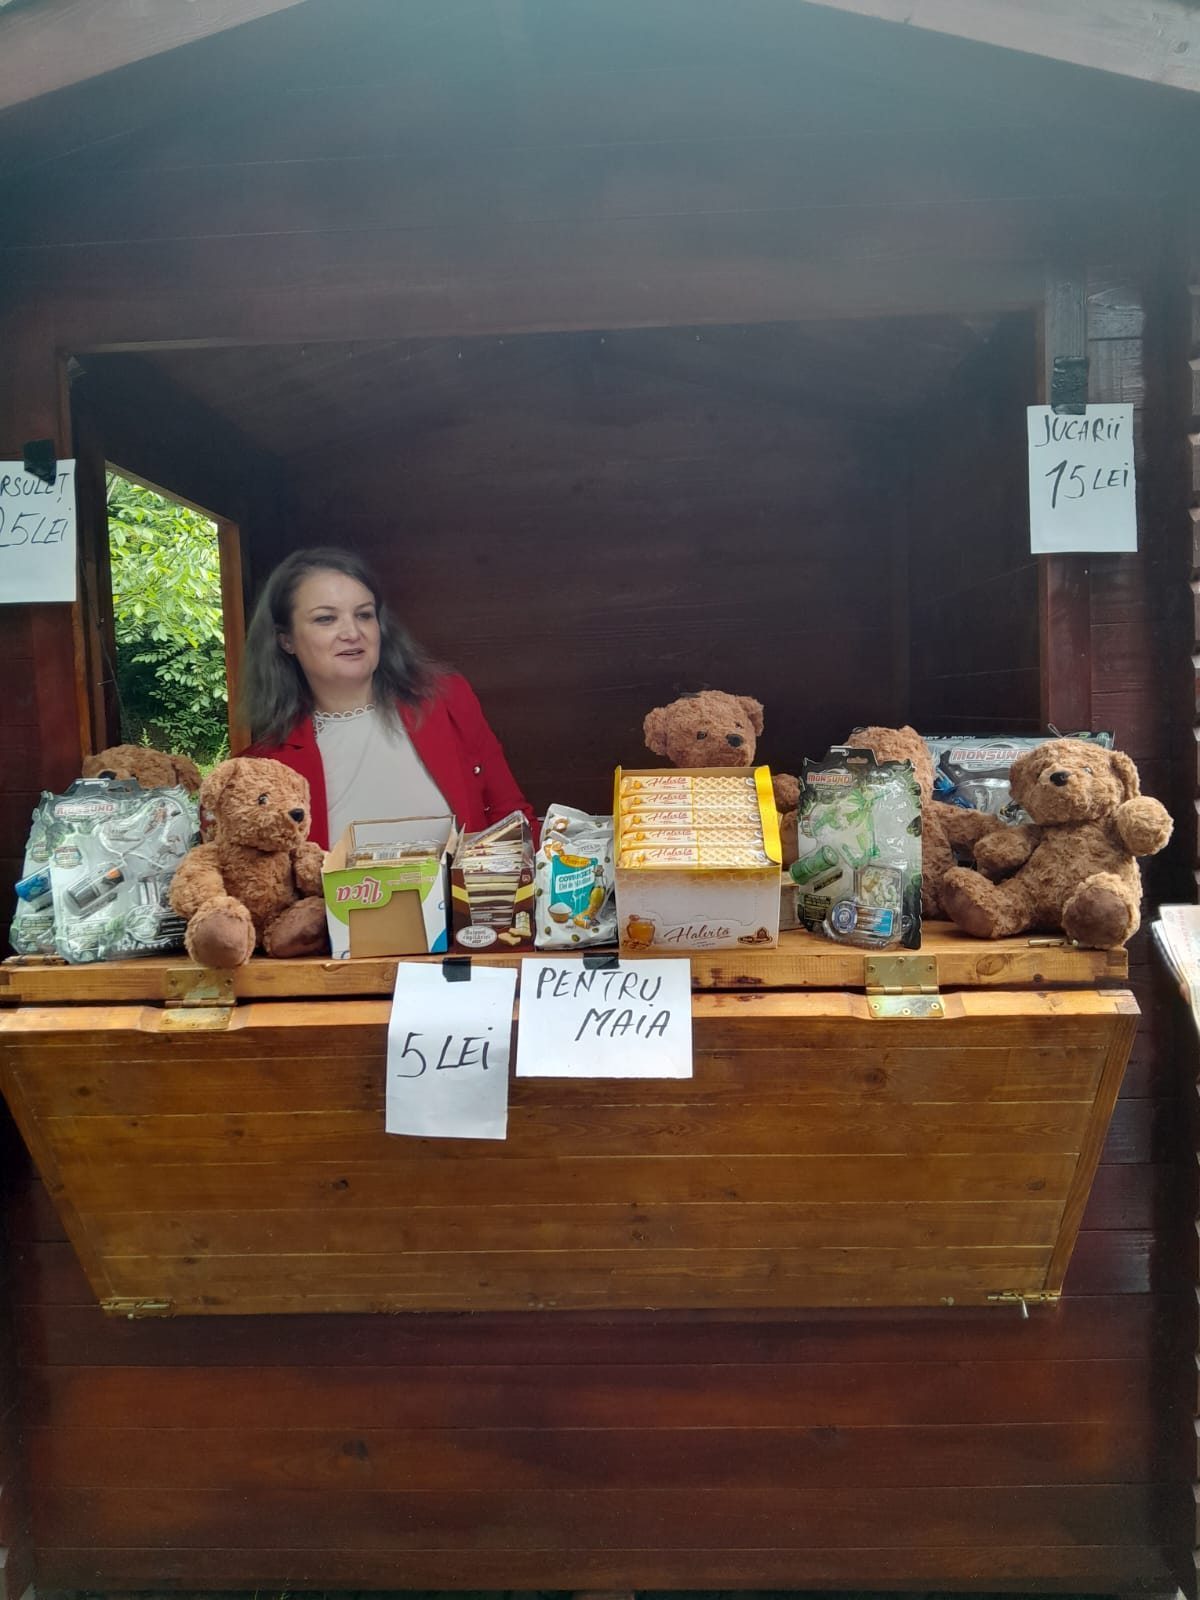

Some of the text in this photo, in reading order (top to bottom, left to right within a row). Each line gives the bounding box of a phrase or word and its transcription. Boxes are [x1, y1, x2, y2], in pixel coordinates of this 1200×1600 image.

[1044, 459, 1087, 509] 15
[536, 967, 662, 1002] PENTRU
[575, 1004, 671, 1041] MAIA
[397, 1032, 427, 1078] 5
